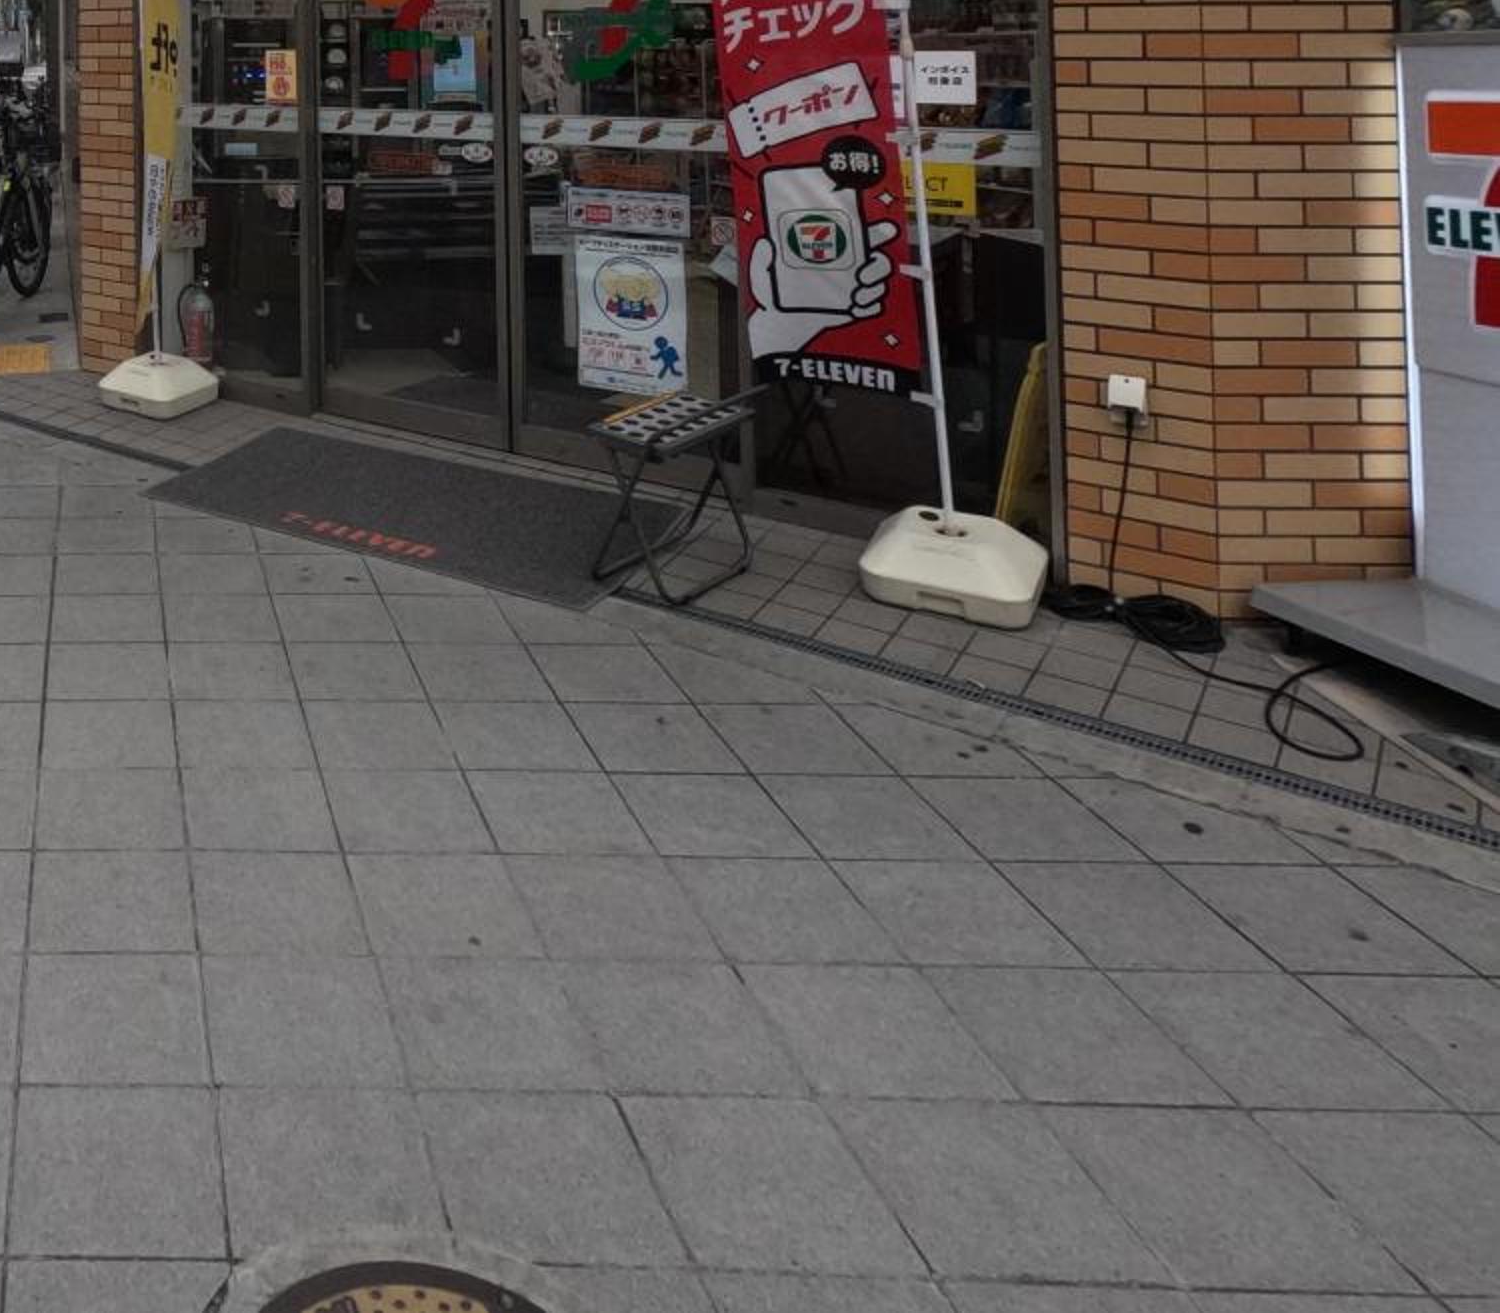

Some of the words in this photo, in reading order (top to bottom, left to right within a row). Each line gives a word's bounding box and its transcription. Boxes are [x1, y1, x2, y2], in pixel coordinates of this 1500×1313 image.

[762, 83, 861, 126] クーポン
[1426, 206, 1500, 252] ELE
